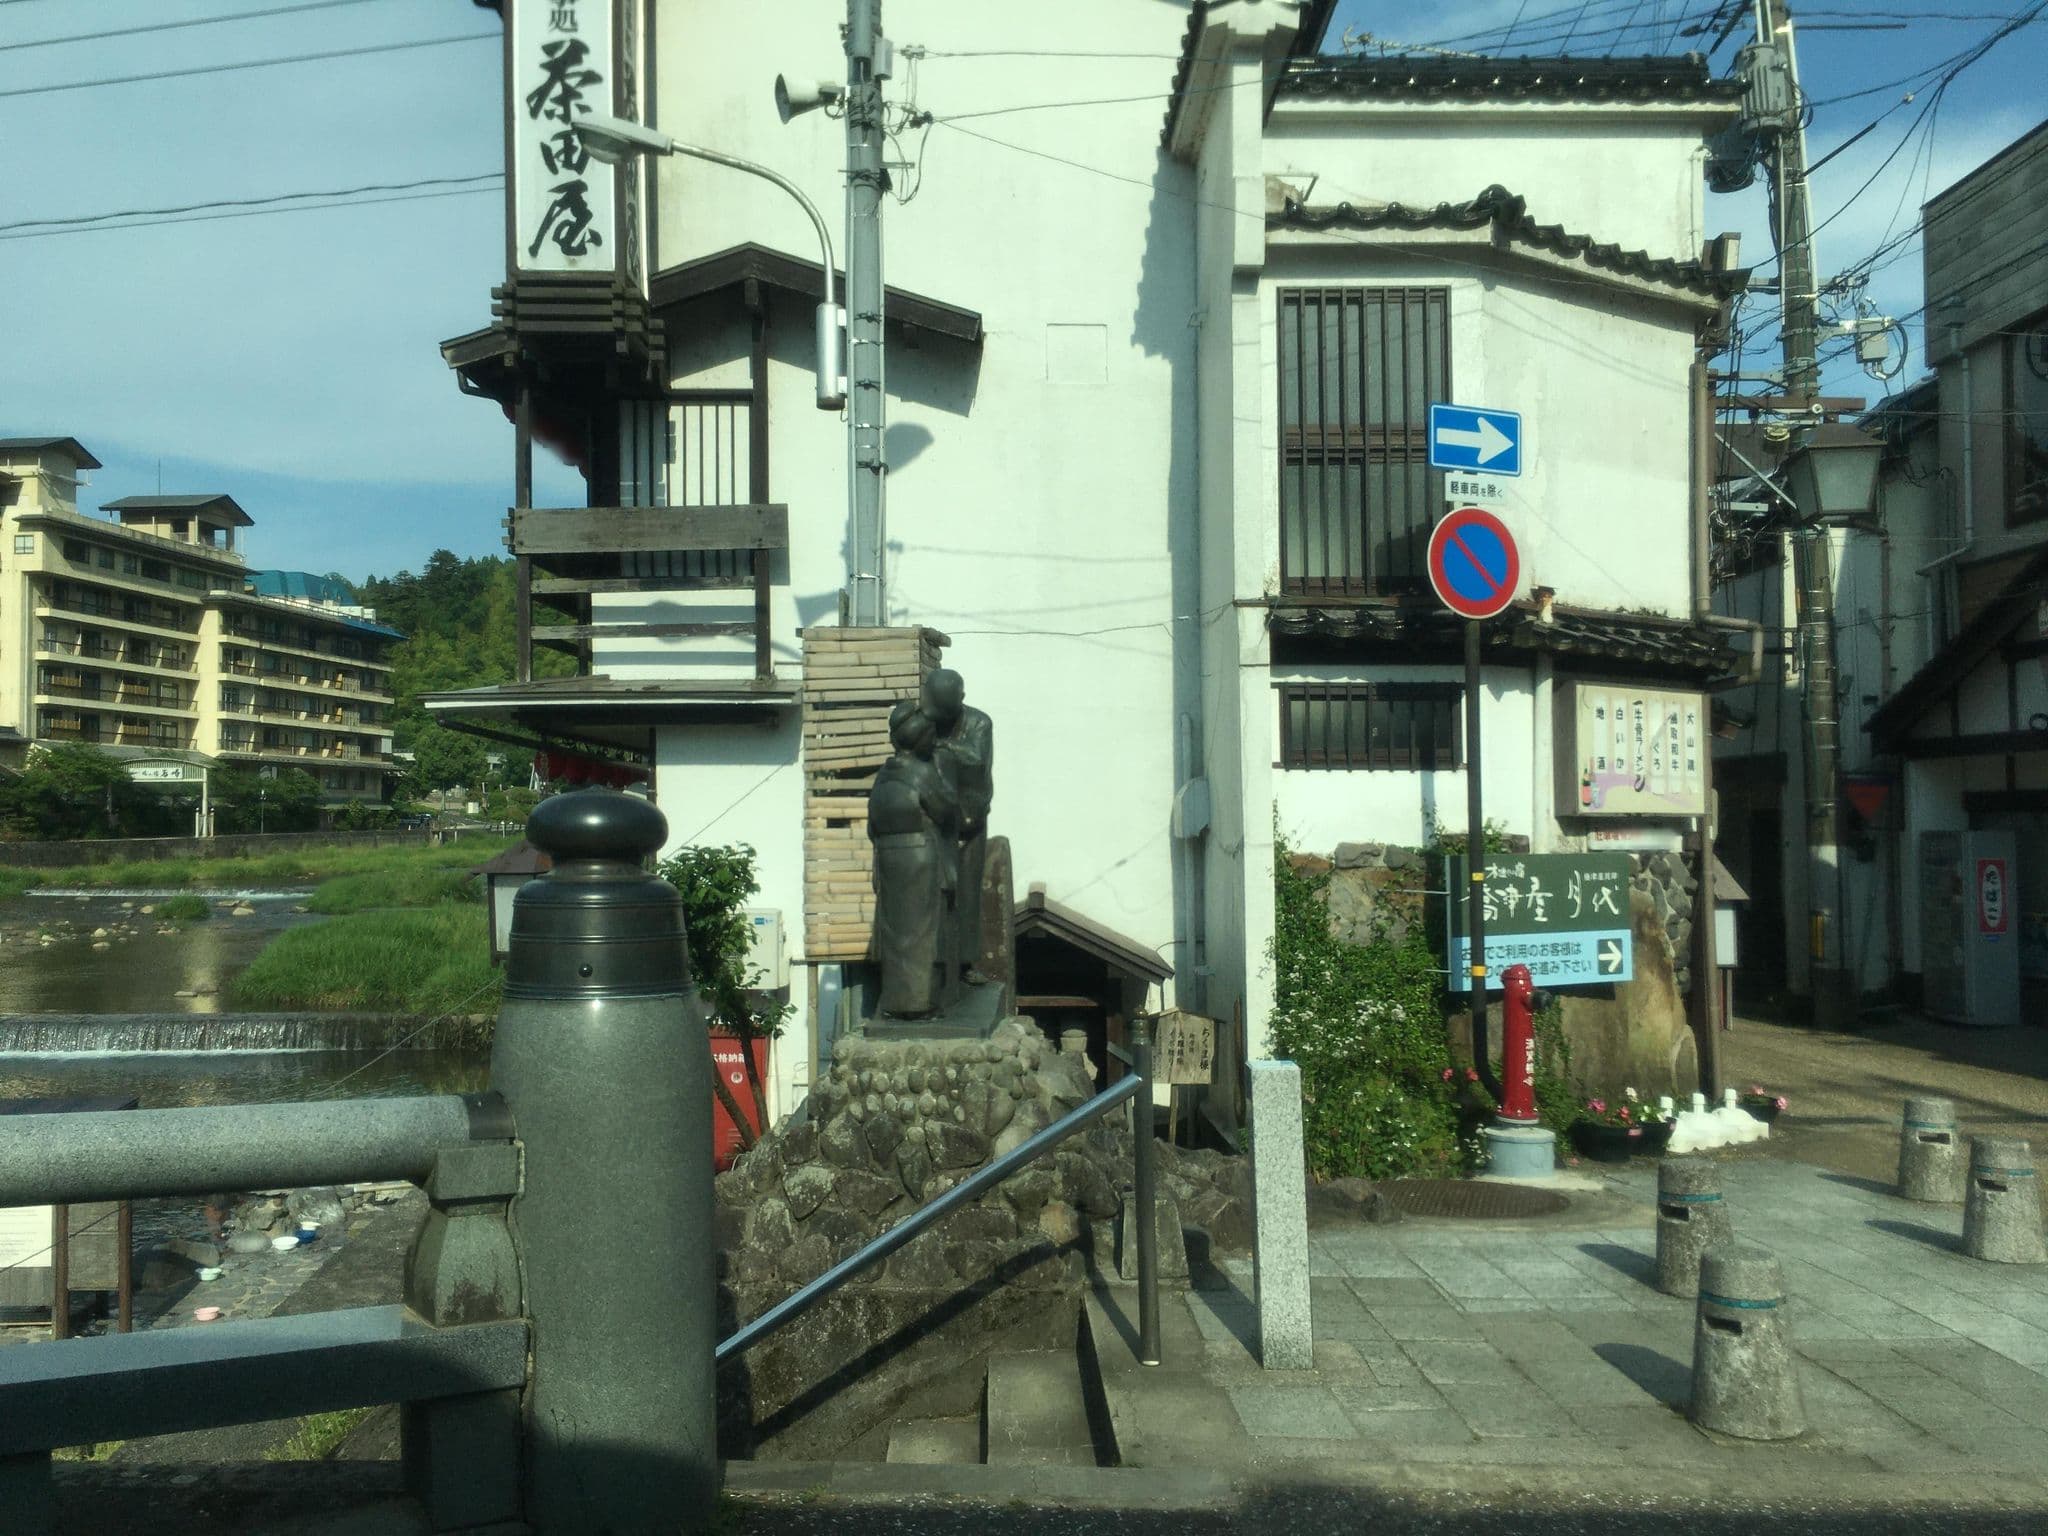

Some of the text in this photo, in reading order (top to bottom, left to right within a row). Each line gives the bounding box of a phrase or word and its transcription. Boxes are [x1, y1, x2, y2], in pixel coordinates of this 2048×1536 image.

[1450, 481, 1503, 498] 軽車両を除く
[1615, 707, 1625, 769] 白いか
